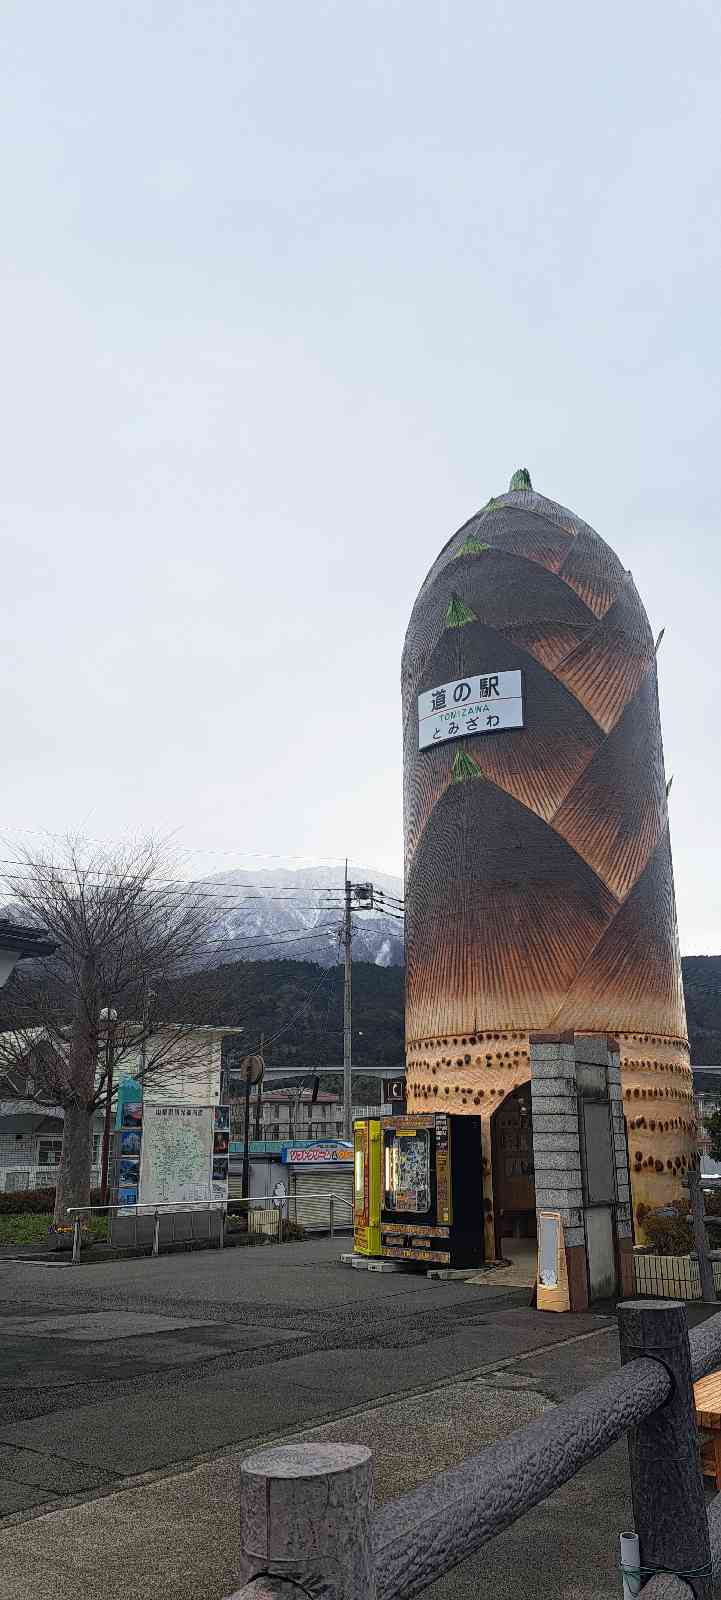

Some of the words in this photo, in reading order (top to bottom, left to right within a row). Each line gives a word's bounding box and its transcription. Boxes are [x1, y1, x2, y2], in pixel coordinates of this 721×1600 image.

[431, 676, 499, 712] 道の駅
[440, 704, 490, 721] TOMIZAWA
[433, 715, 499, 739] とみざわ
